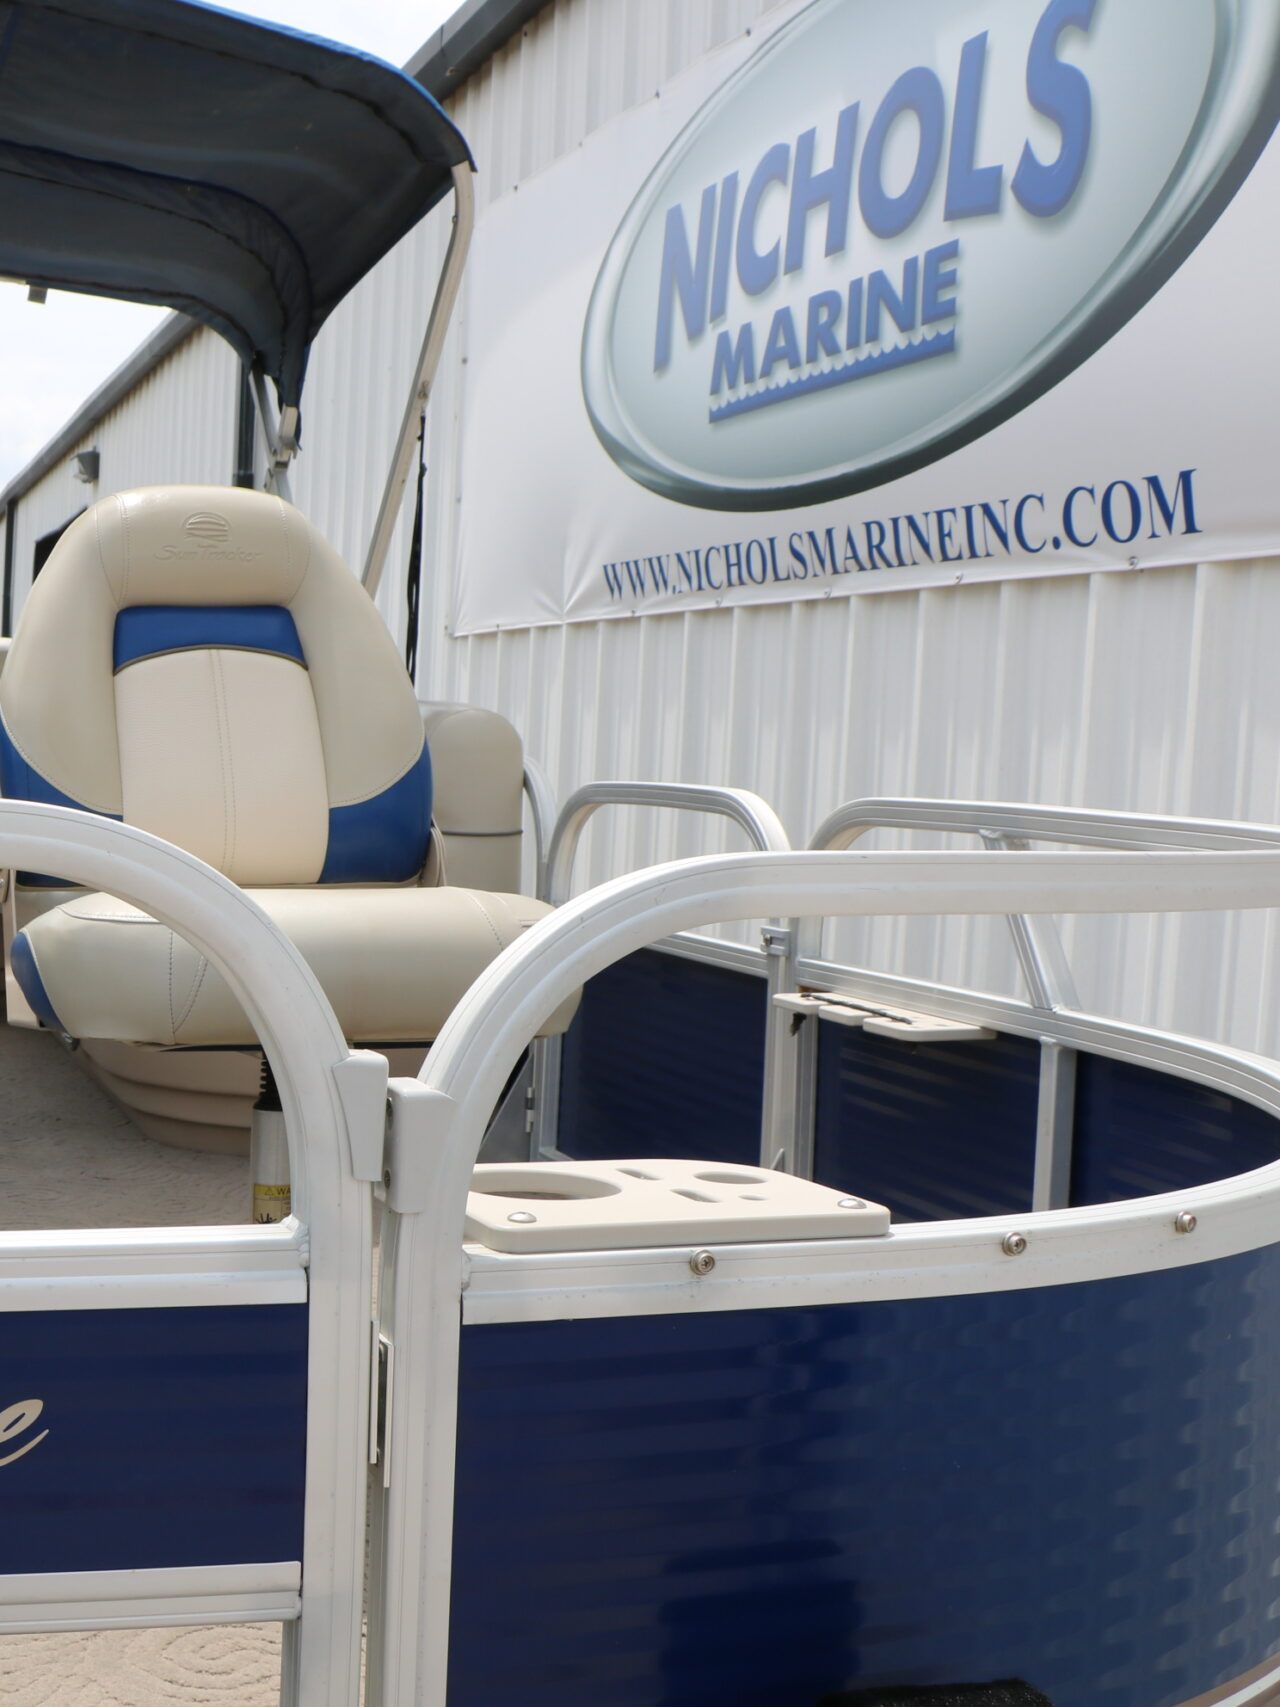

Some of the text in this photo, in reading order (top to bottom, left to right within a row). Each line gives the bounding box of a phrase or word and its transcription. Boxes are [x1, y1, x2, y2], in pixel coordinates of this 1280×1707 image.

[653, 0, 1094, 374] NICHOLS
[709, 239, 961, 397] MARINE
[602, 468, 1203, 602] WWW.NICHOLSMARINEINC.COM
